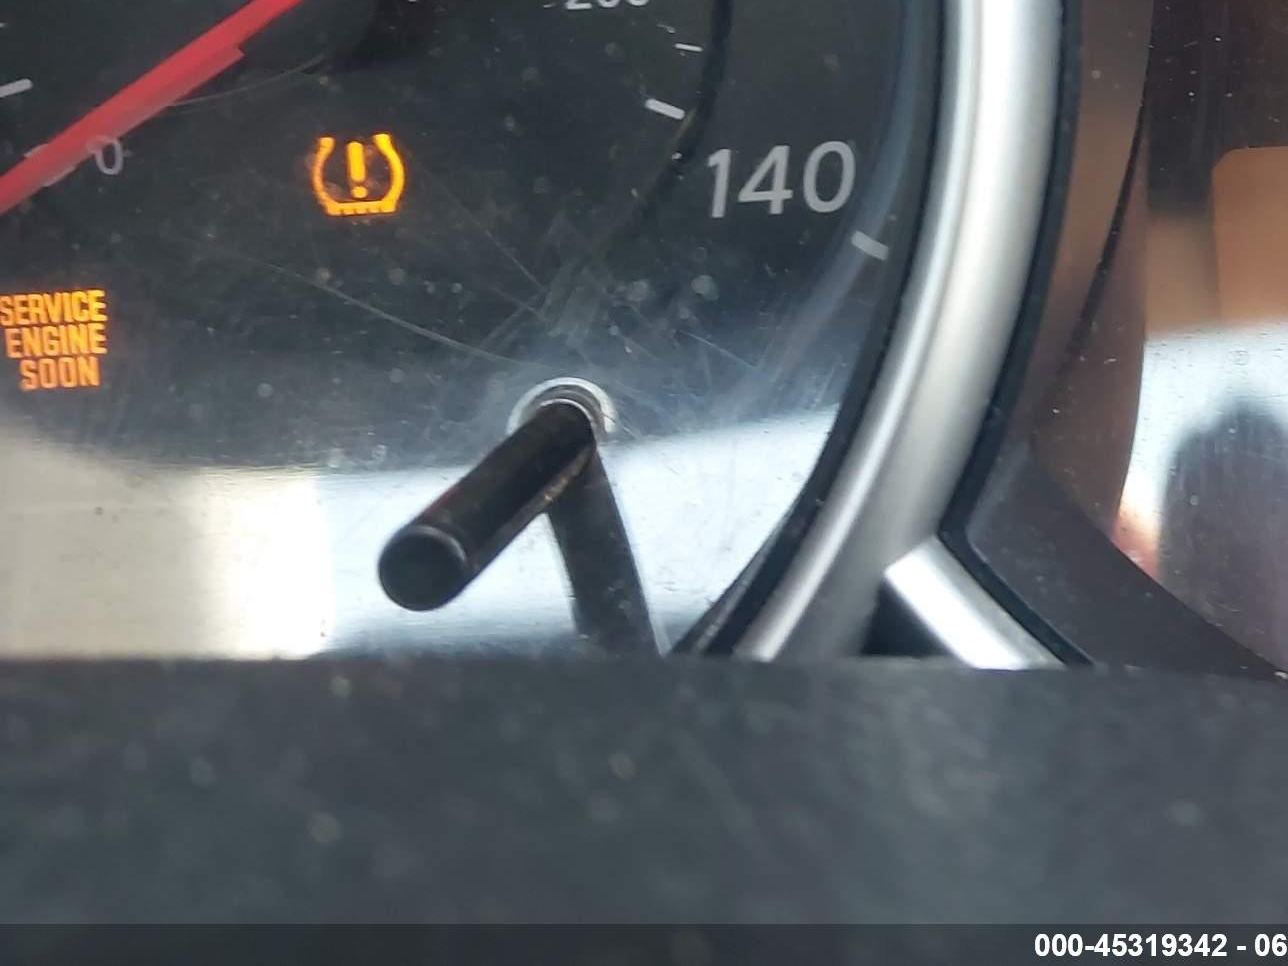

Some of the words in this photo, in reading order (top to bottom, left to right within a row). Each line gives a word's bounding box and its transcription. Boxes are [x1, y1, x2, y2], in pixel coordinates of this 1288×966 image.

[707, 140, 856, 218] 140
[0, 289, 107, 327] SERVICE
[5, 324, 107, 358] ENGINE
[20, 356, 101, 390] SOON
